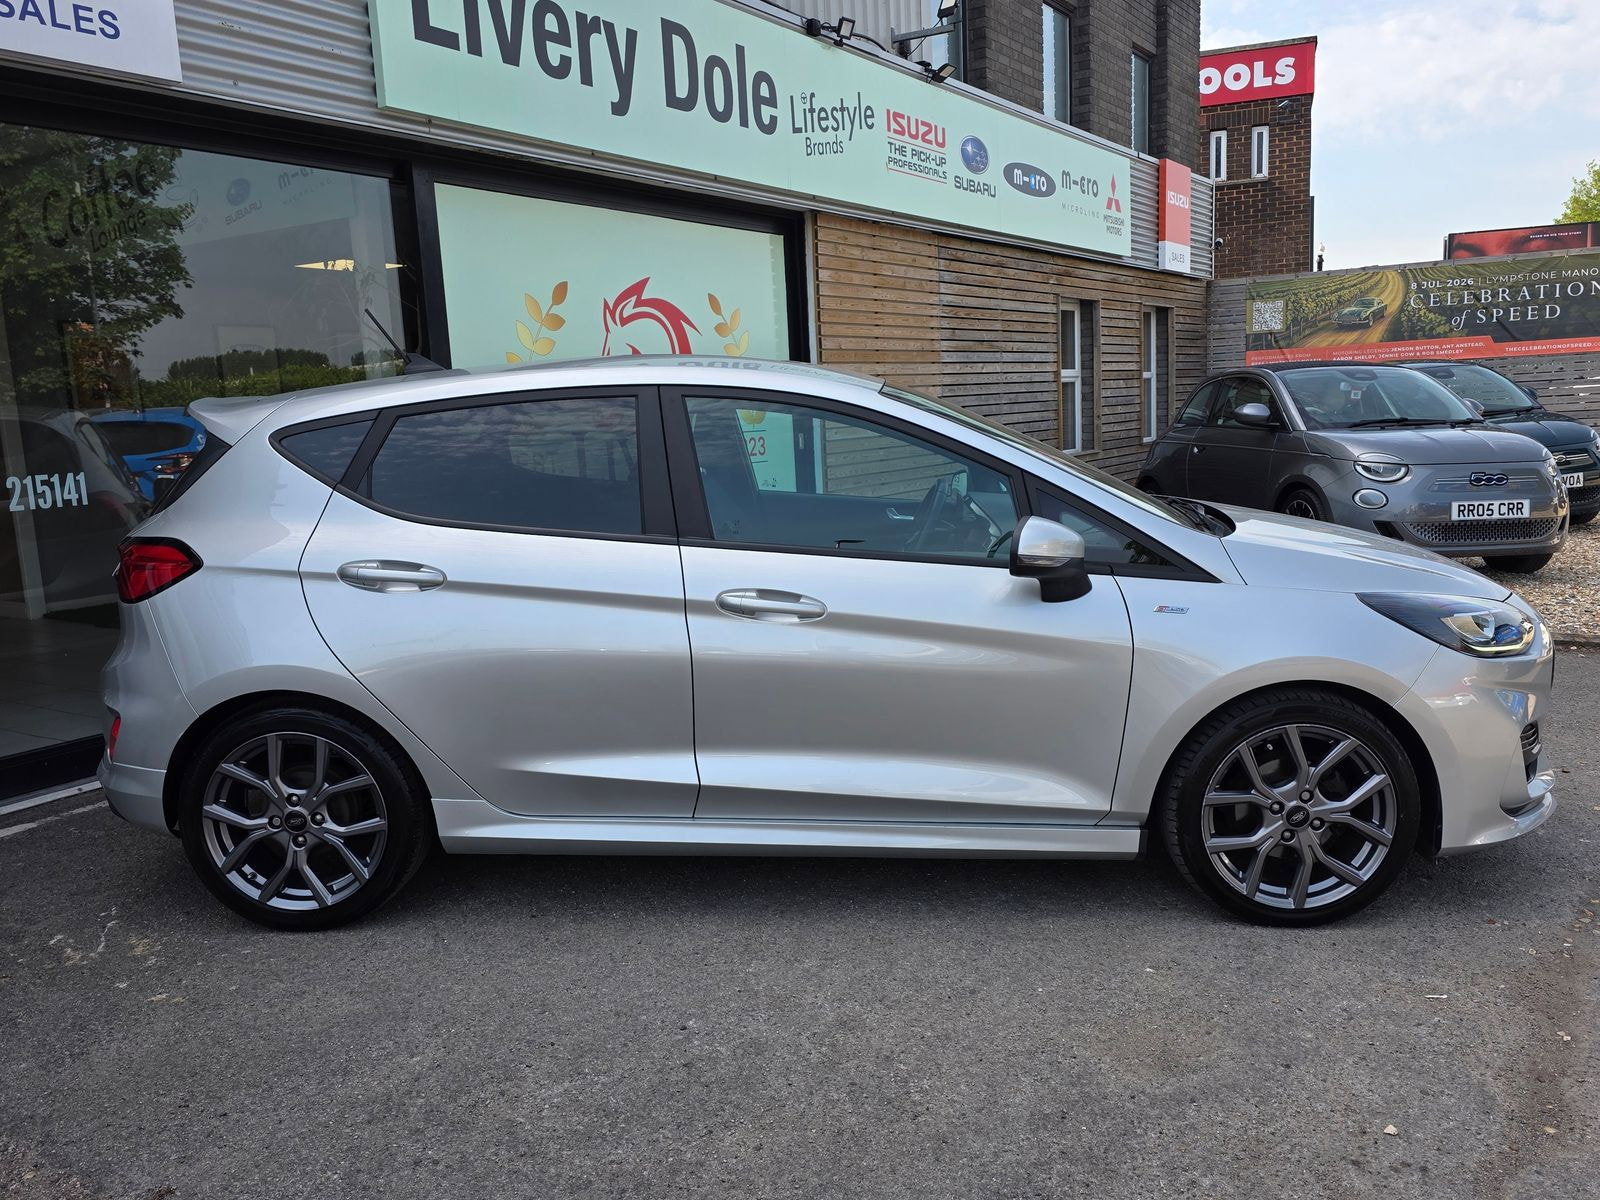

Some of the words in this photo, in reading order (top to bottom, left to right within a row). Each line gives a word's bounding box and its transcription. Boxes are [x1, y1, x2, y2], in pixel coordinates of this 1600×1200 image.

[660, 17, 778, 136] Dole
[790, 92, 875, 141] Lifestyle
[886, 108, 946, 148] ISUZU
[805, 134, 844, 157] Brands
[887, 141, 907, 158] THE
[911, 147, 947, 168] PICK-UP
[888, 156, 948, 180] PROFESSIONALS
[953, 175, 997, 198] SUBARU
[1167, 190, 1189, 209] ISUZU
[224, 200, 263, 225] SUBARU
[1171, 251, 1185, 264] SALES
[1422, 281, 1442, 289] JUL
[1447, 278, 1474, 287] 2026
[1486, 271, 1557, 284] LYMPSTONE
[1451, 309, 1471, 331] of
[1476, 304, 1561, 324] SPEED
[6, 471, 89, 512] 215141
[1498, 501, 1524, 516] CRR
